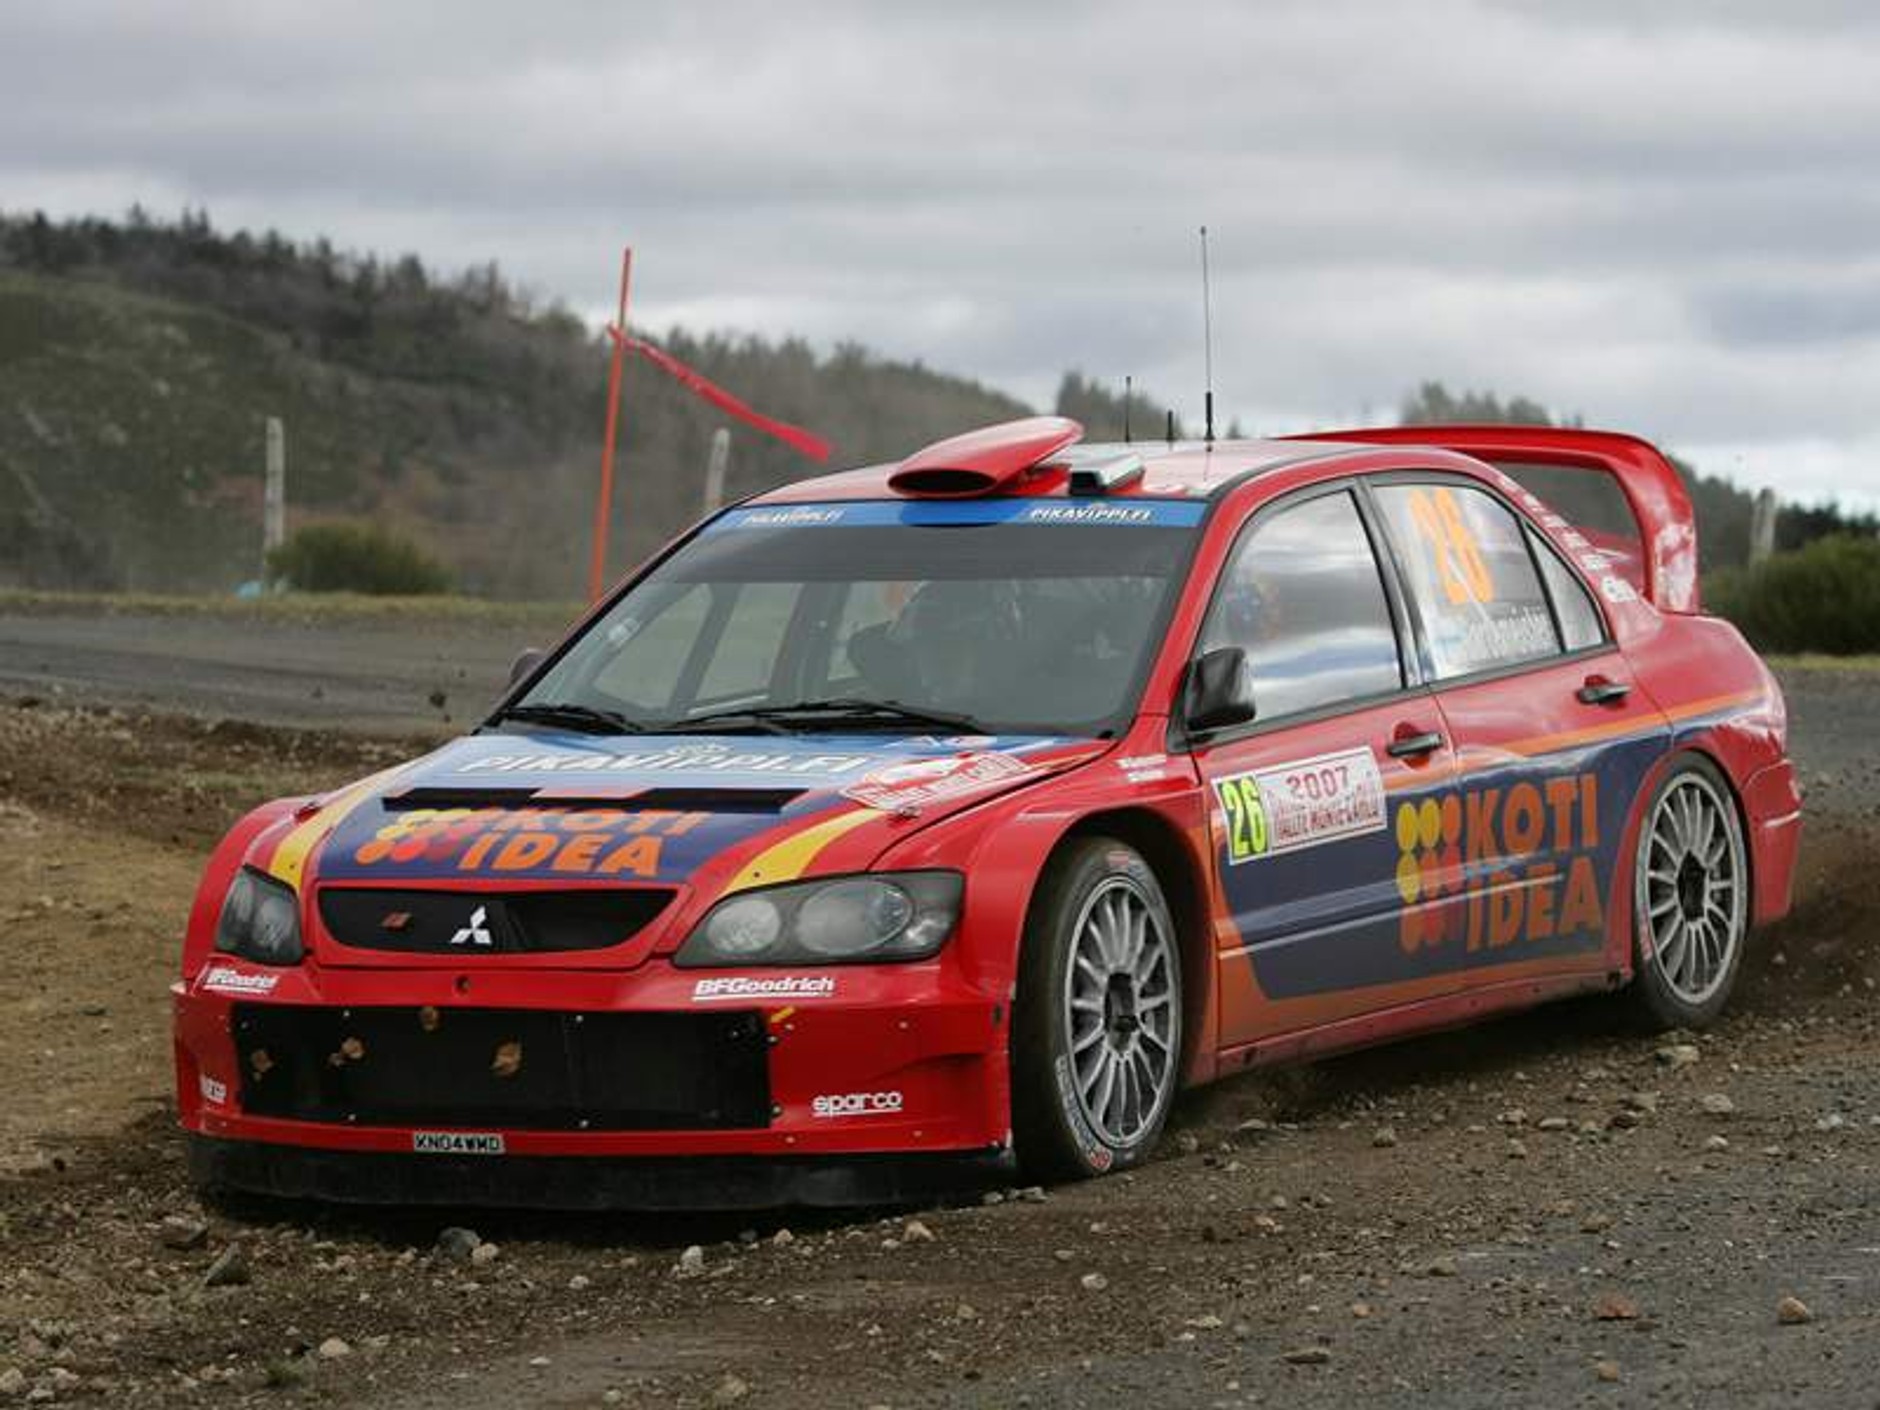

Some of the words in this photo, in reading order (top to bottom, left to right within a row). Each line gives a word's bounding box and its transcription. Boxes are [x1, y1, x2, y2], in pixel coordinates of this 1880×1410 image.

[1286, 765, 1349, 800] 2007
[1221, 776, 1267, 858] 26
[1466, 773, 1598, 868] KOTI
[457, 831, 664, 877] IDEA
[1466, 857, 1602, 952] IDEA
[693, 976, 835, 1001] BFGoodrich
[812, 1092, 902, 1117] sparco
